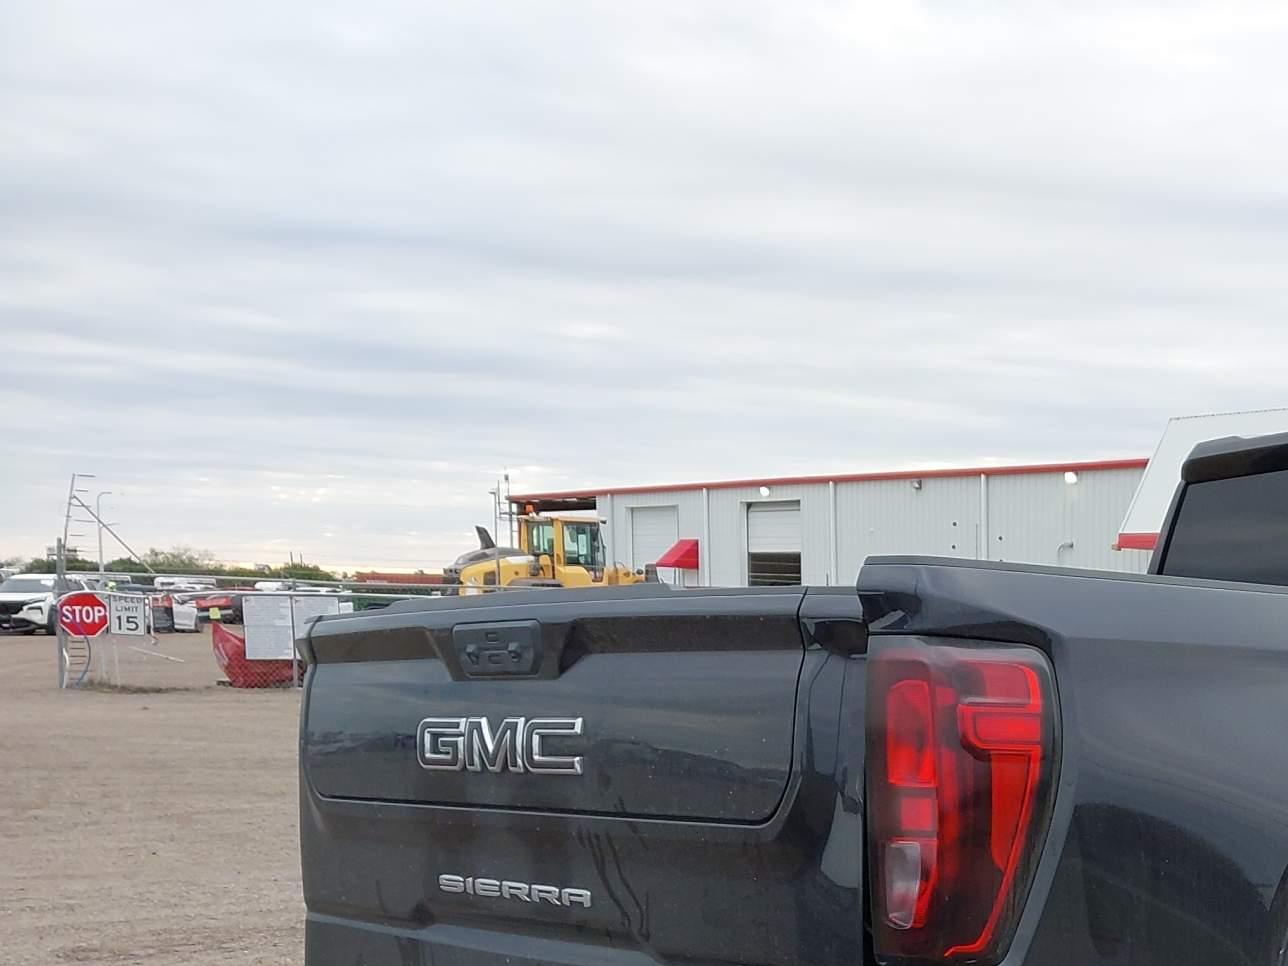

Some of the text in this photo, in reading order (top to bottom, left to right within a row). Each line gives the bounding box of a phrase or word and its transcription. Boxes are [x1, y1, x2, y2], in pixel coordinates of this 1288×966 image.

[111, 595, 143, 604] SPEED
[62, 605, 105, 624] STOP
[115, 605, 139, 613] LIMIT
[116, 615, 140, 632] 15
[417, 716, 584, 775] GMC
[438, 874, 592, 908] SIERRA
